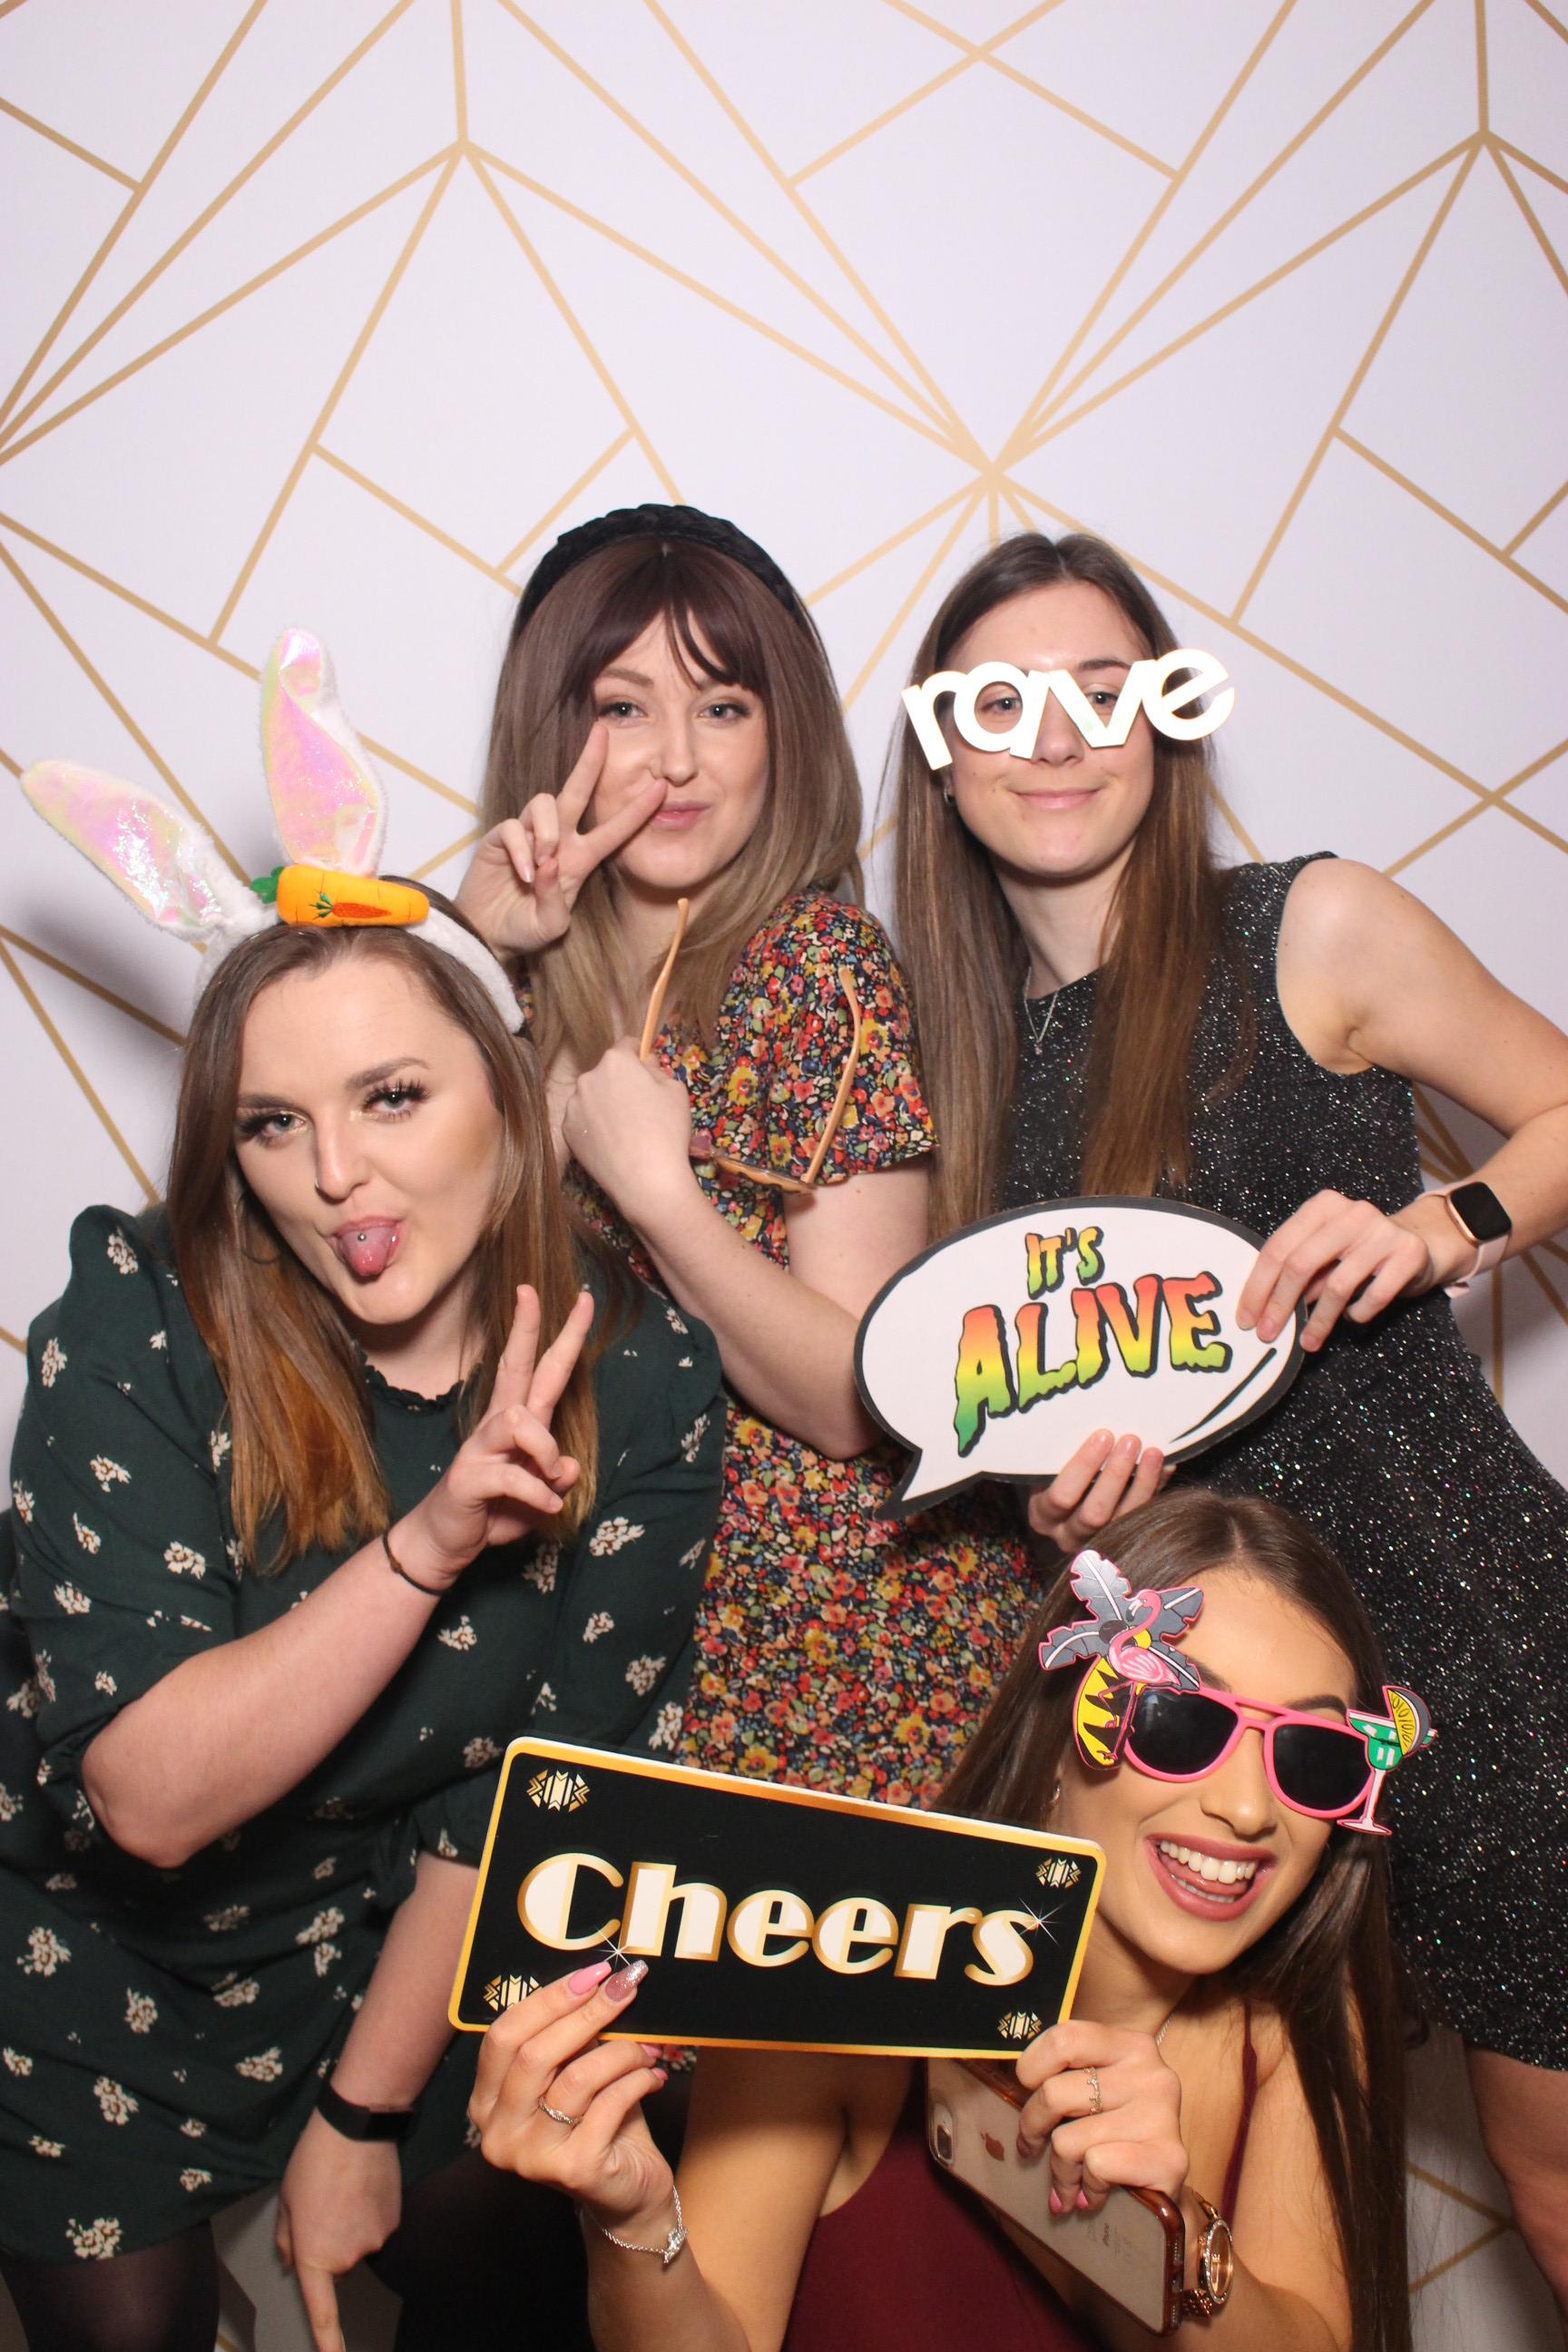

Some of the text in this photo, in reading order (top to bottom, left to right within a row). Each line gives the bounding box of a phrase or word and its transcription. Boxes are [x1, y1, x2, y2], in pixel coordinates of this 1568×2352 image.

[900, 648, 1235, 770] rave
[1025, 1226, 1104, 1299] IT'S
[953, 1270, 1232, 1457] ALIVE
[516, 1852, 1041, 1986] Cheers
